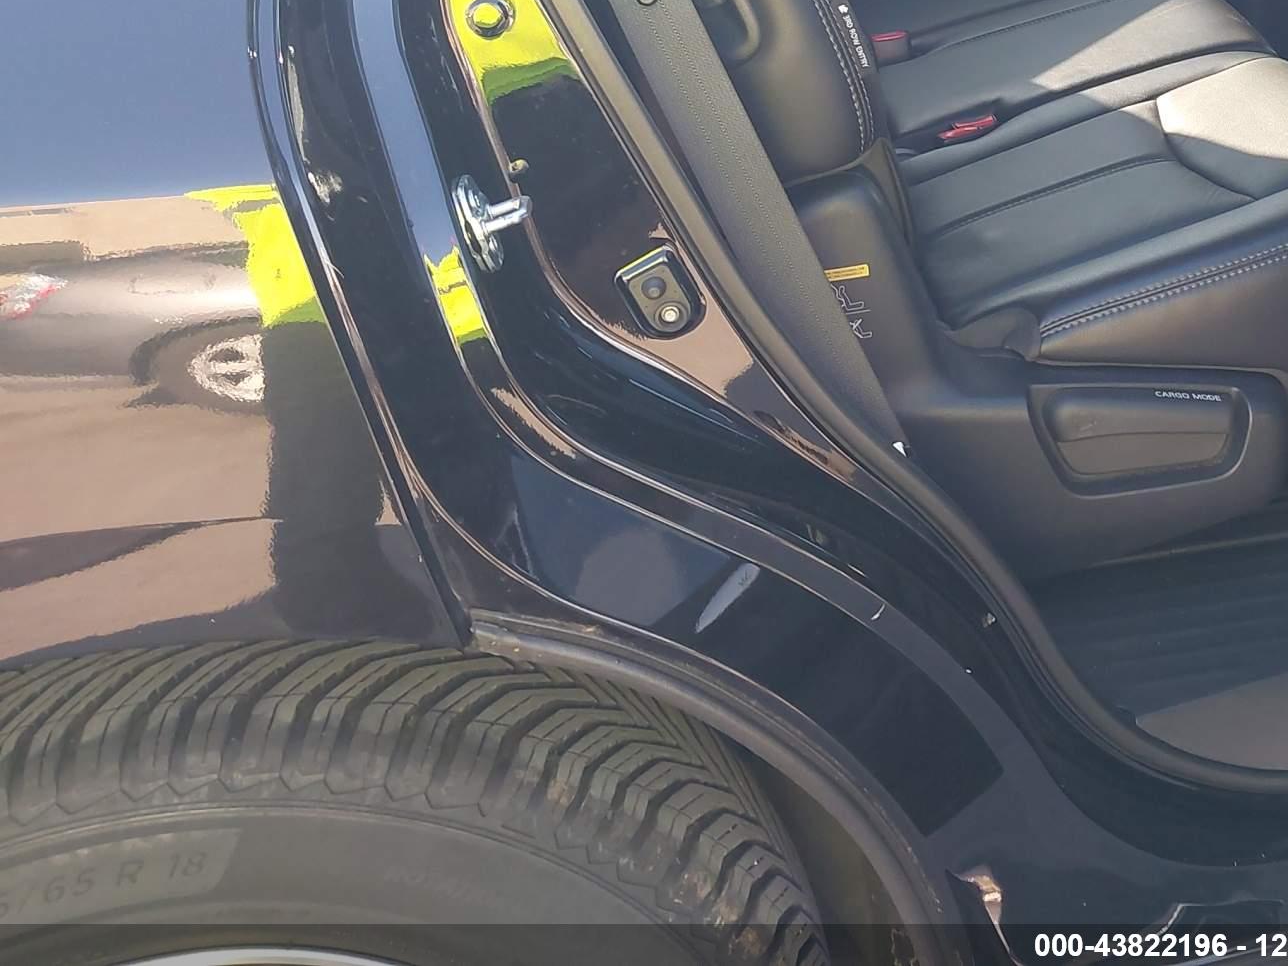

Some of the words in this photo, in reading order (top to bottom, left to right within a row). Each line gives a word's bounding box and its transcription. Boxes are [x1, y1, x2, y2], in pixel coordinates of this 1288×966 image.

[842, 14, 854, 28] 3RD
[849, 28, 861, 45] ROW
[855, 45, 870, 68] ENTRY
[1154, 390, 1190, 400] CARGO
[1191, 392, 1222, 402] MODE
[115, 859, 145, 888] R
[168, 850, 208, 880] 18
